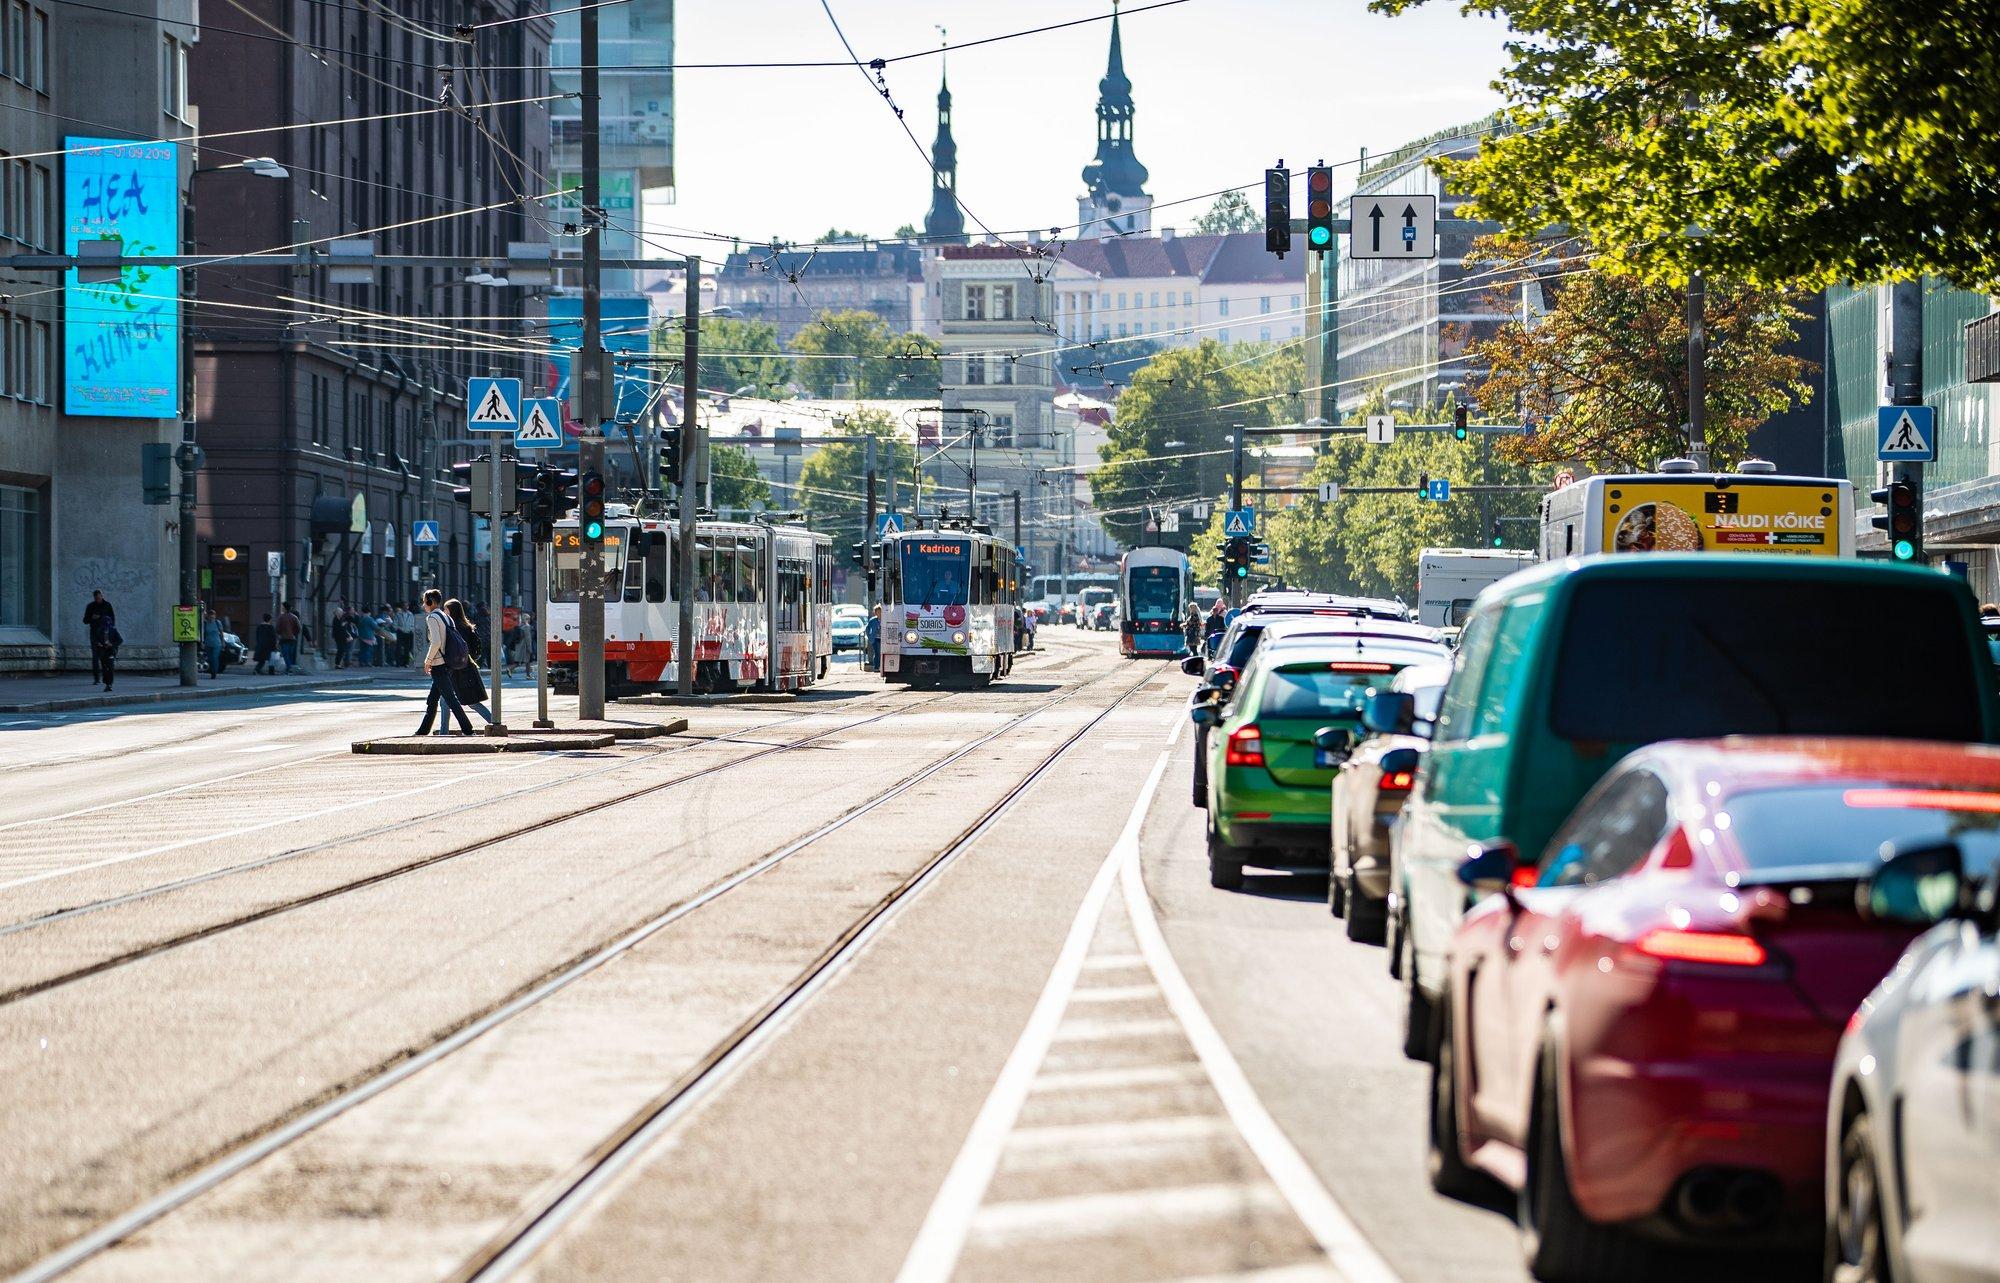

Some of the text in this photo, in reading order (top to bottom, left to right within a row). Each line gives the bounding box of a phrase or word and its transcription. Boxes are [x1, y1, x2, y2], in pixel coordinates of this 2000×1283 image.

[82, 168, 148, 225] HEA
[74, 302, 165, 381] KUNST
[1715, 511, 1825, 529] NAUDI KÕIKE
[554, 534, 563, 547] 2
[906, 544, 960, 555] 1 Kadriorg
